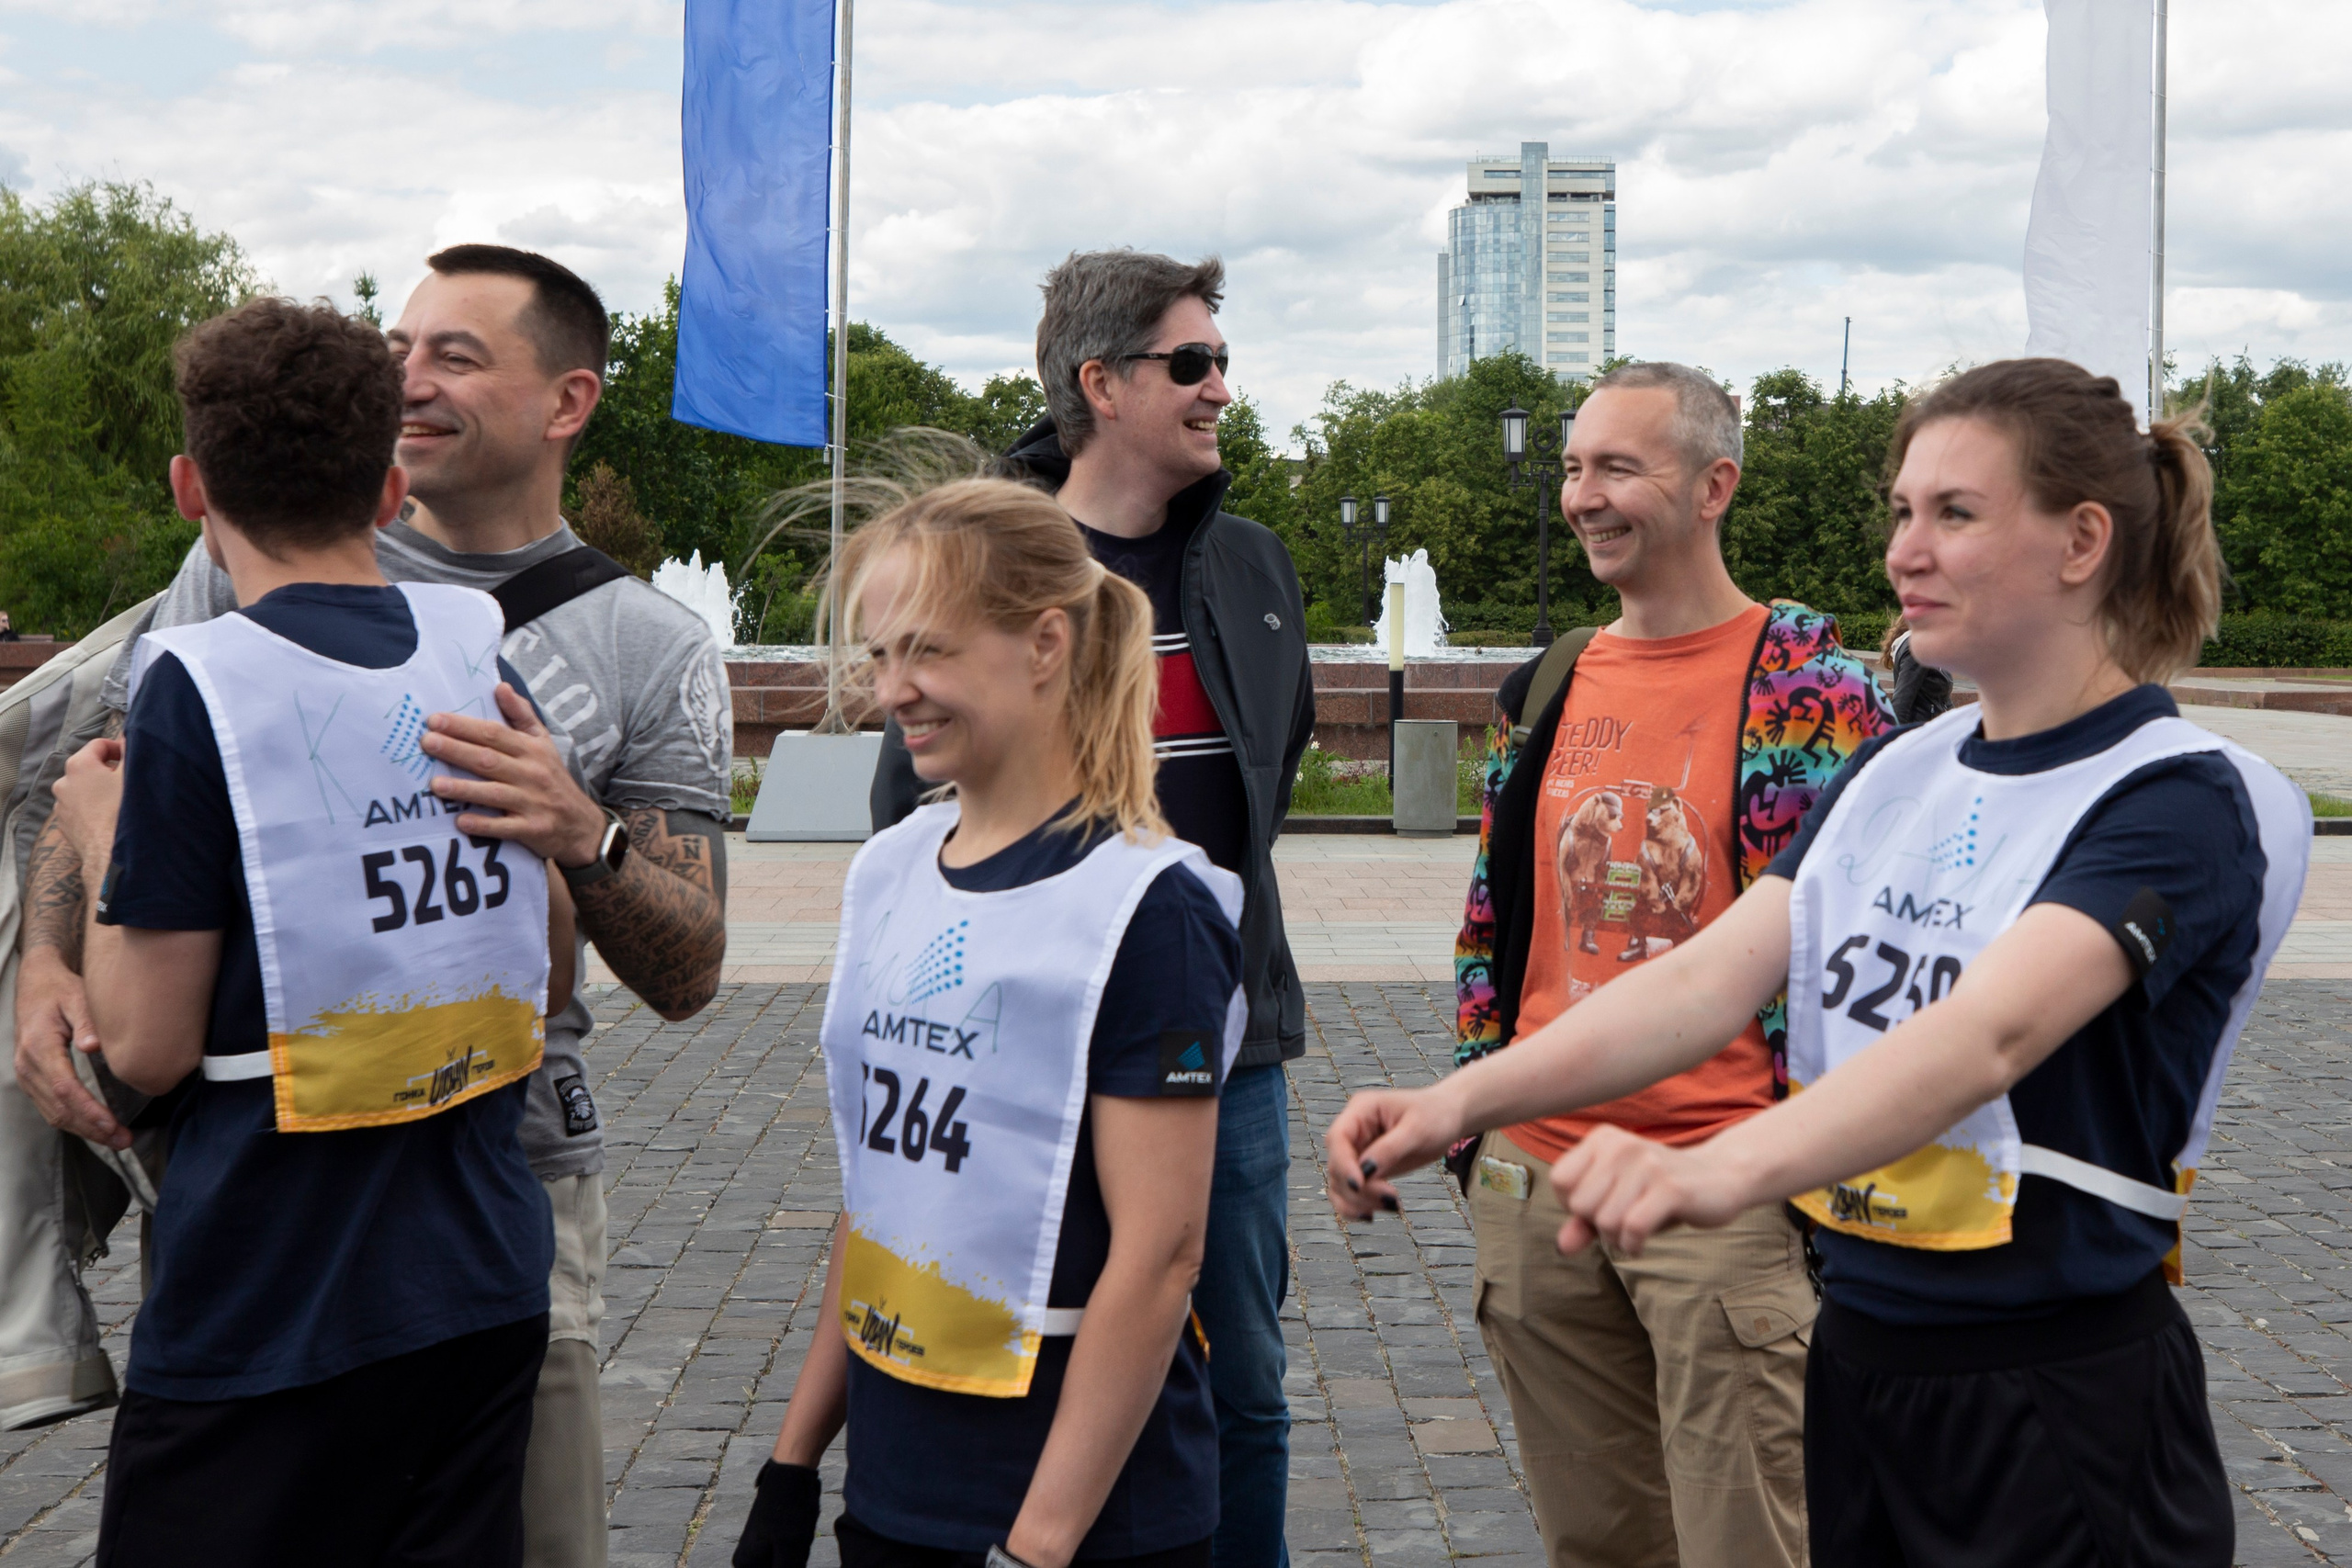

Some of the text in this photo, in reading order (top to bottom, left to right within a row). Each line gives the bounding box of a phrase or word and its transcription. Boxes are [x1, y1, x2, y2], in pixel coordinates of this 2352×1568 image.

[1559, 717, 1634, 752] TEDDY
[364, 789, 471, 829] AMTE
[361, 834, 511, 934] 5263
[862, 1009, 980, 1060] AMTEX
[1165, 1071, 1213, 1083] AMTEX
[859, 1061, 971, 1174] 264
